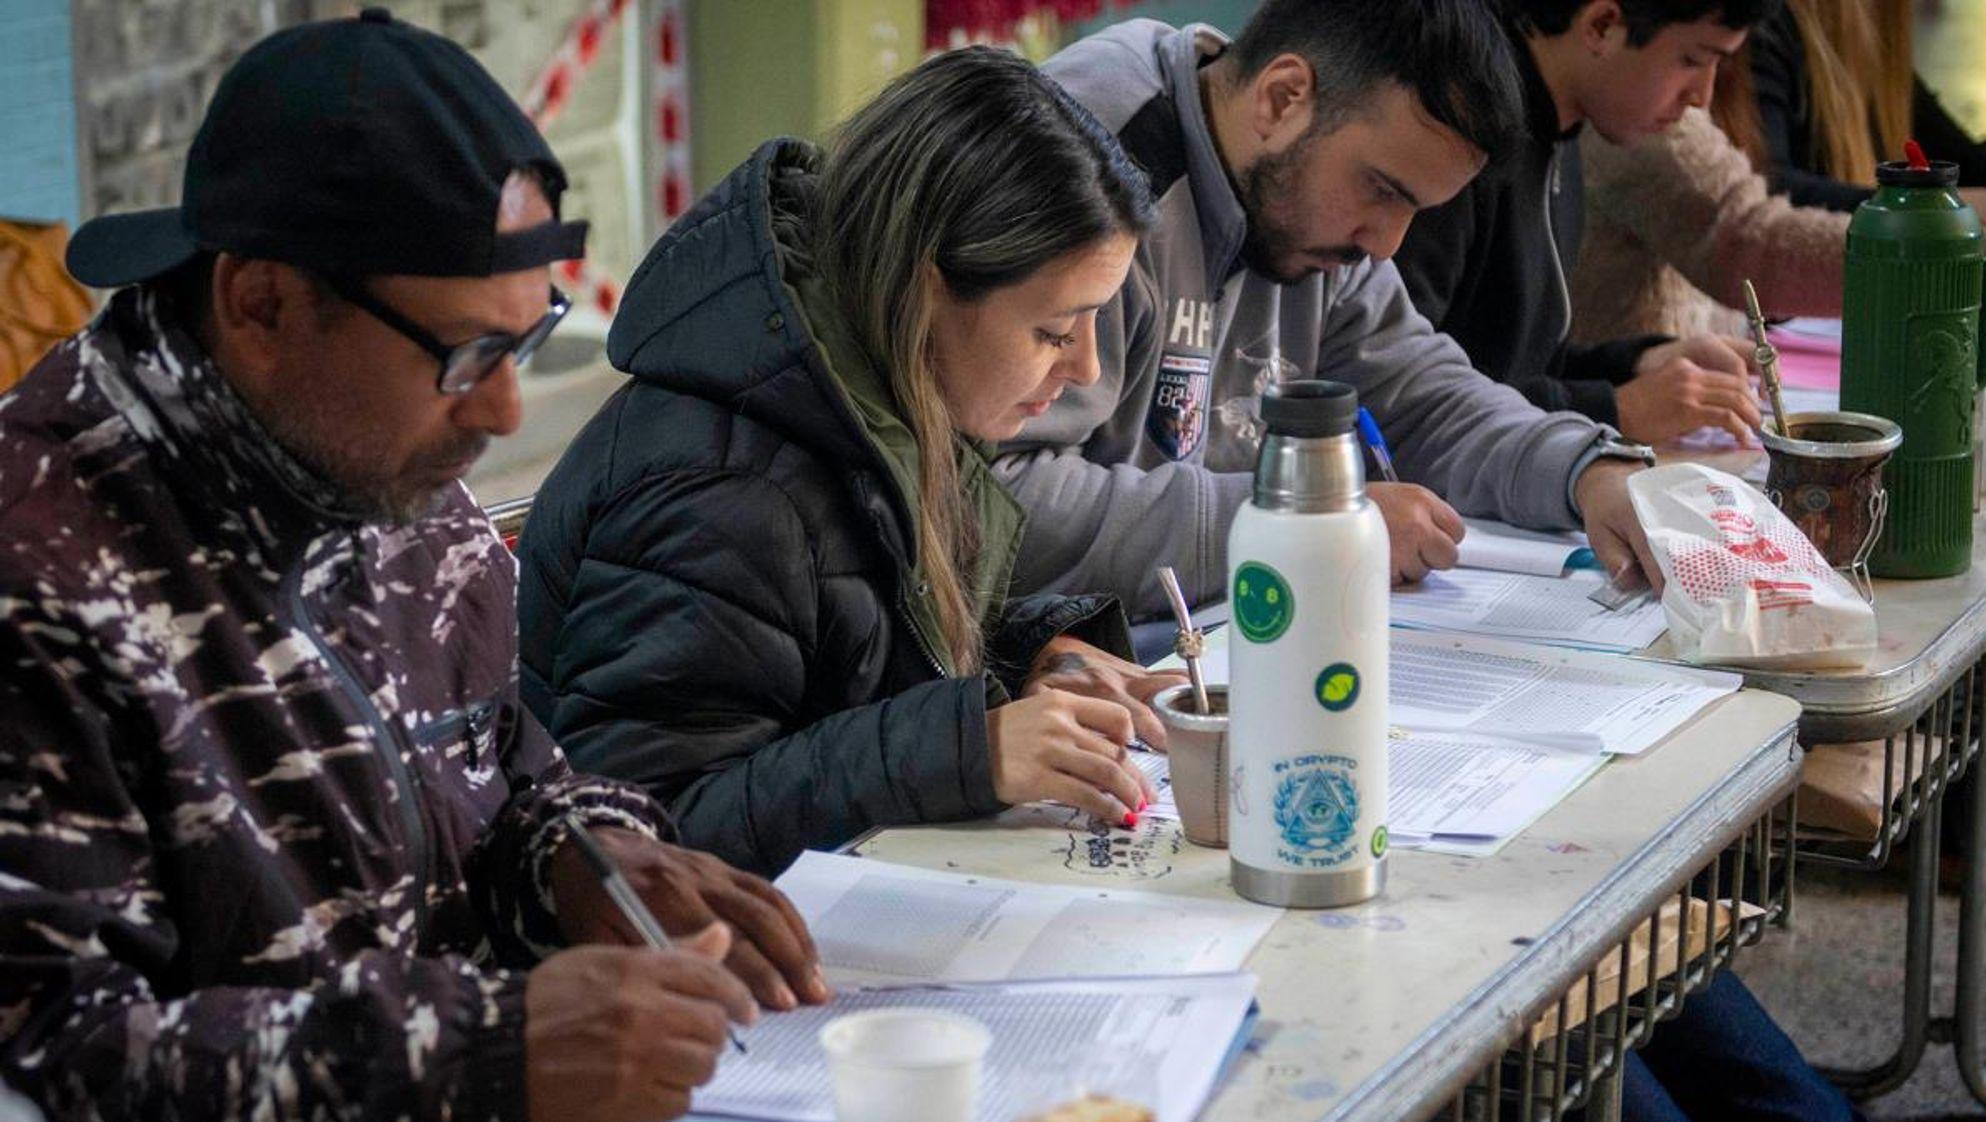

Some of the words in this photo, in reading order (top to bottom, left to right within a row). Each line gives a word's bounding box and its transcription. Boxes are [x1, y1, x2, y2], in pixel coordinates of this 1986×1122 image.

[1294, 754, 1358, 771] CRYPTO
[1277, 848, 1303, 867] WE
[1309, 844, 1360, 868] TRUST
